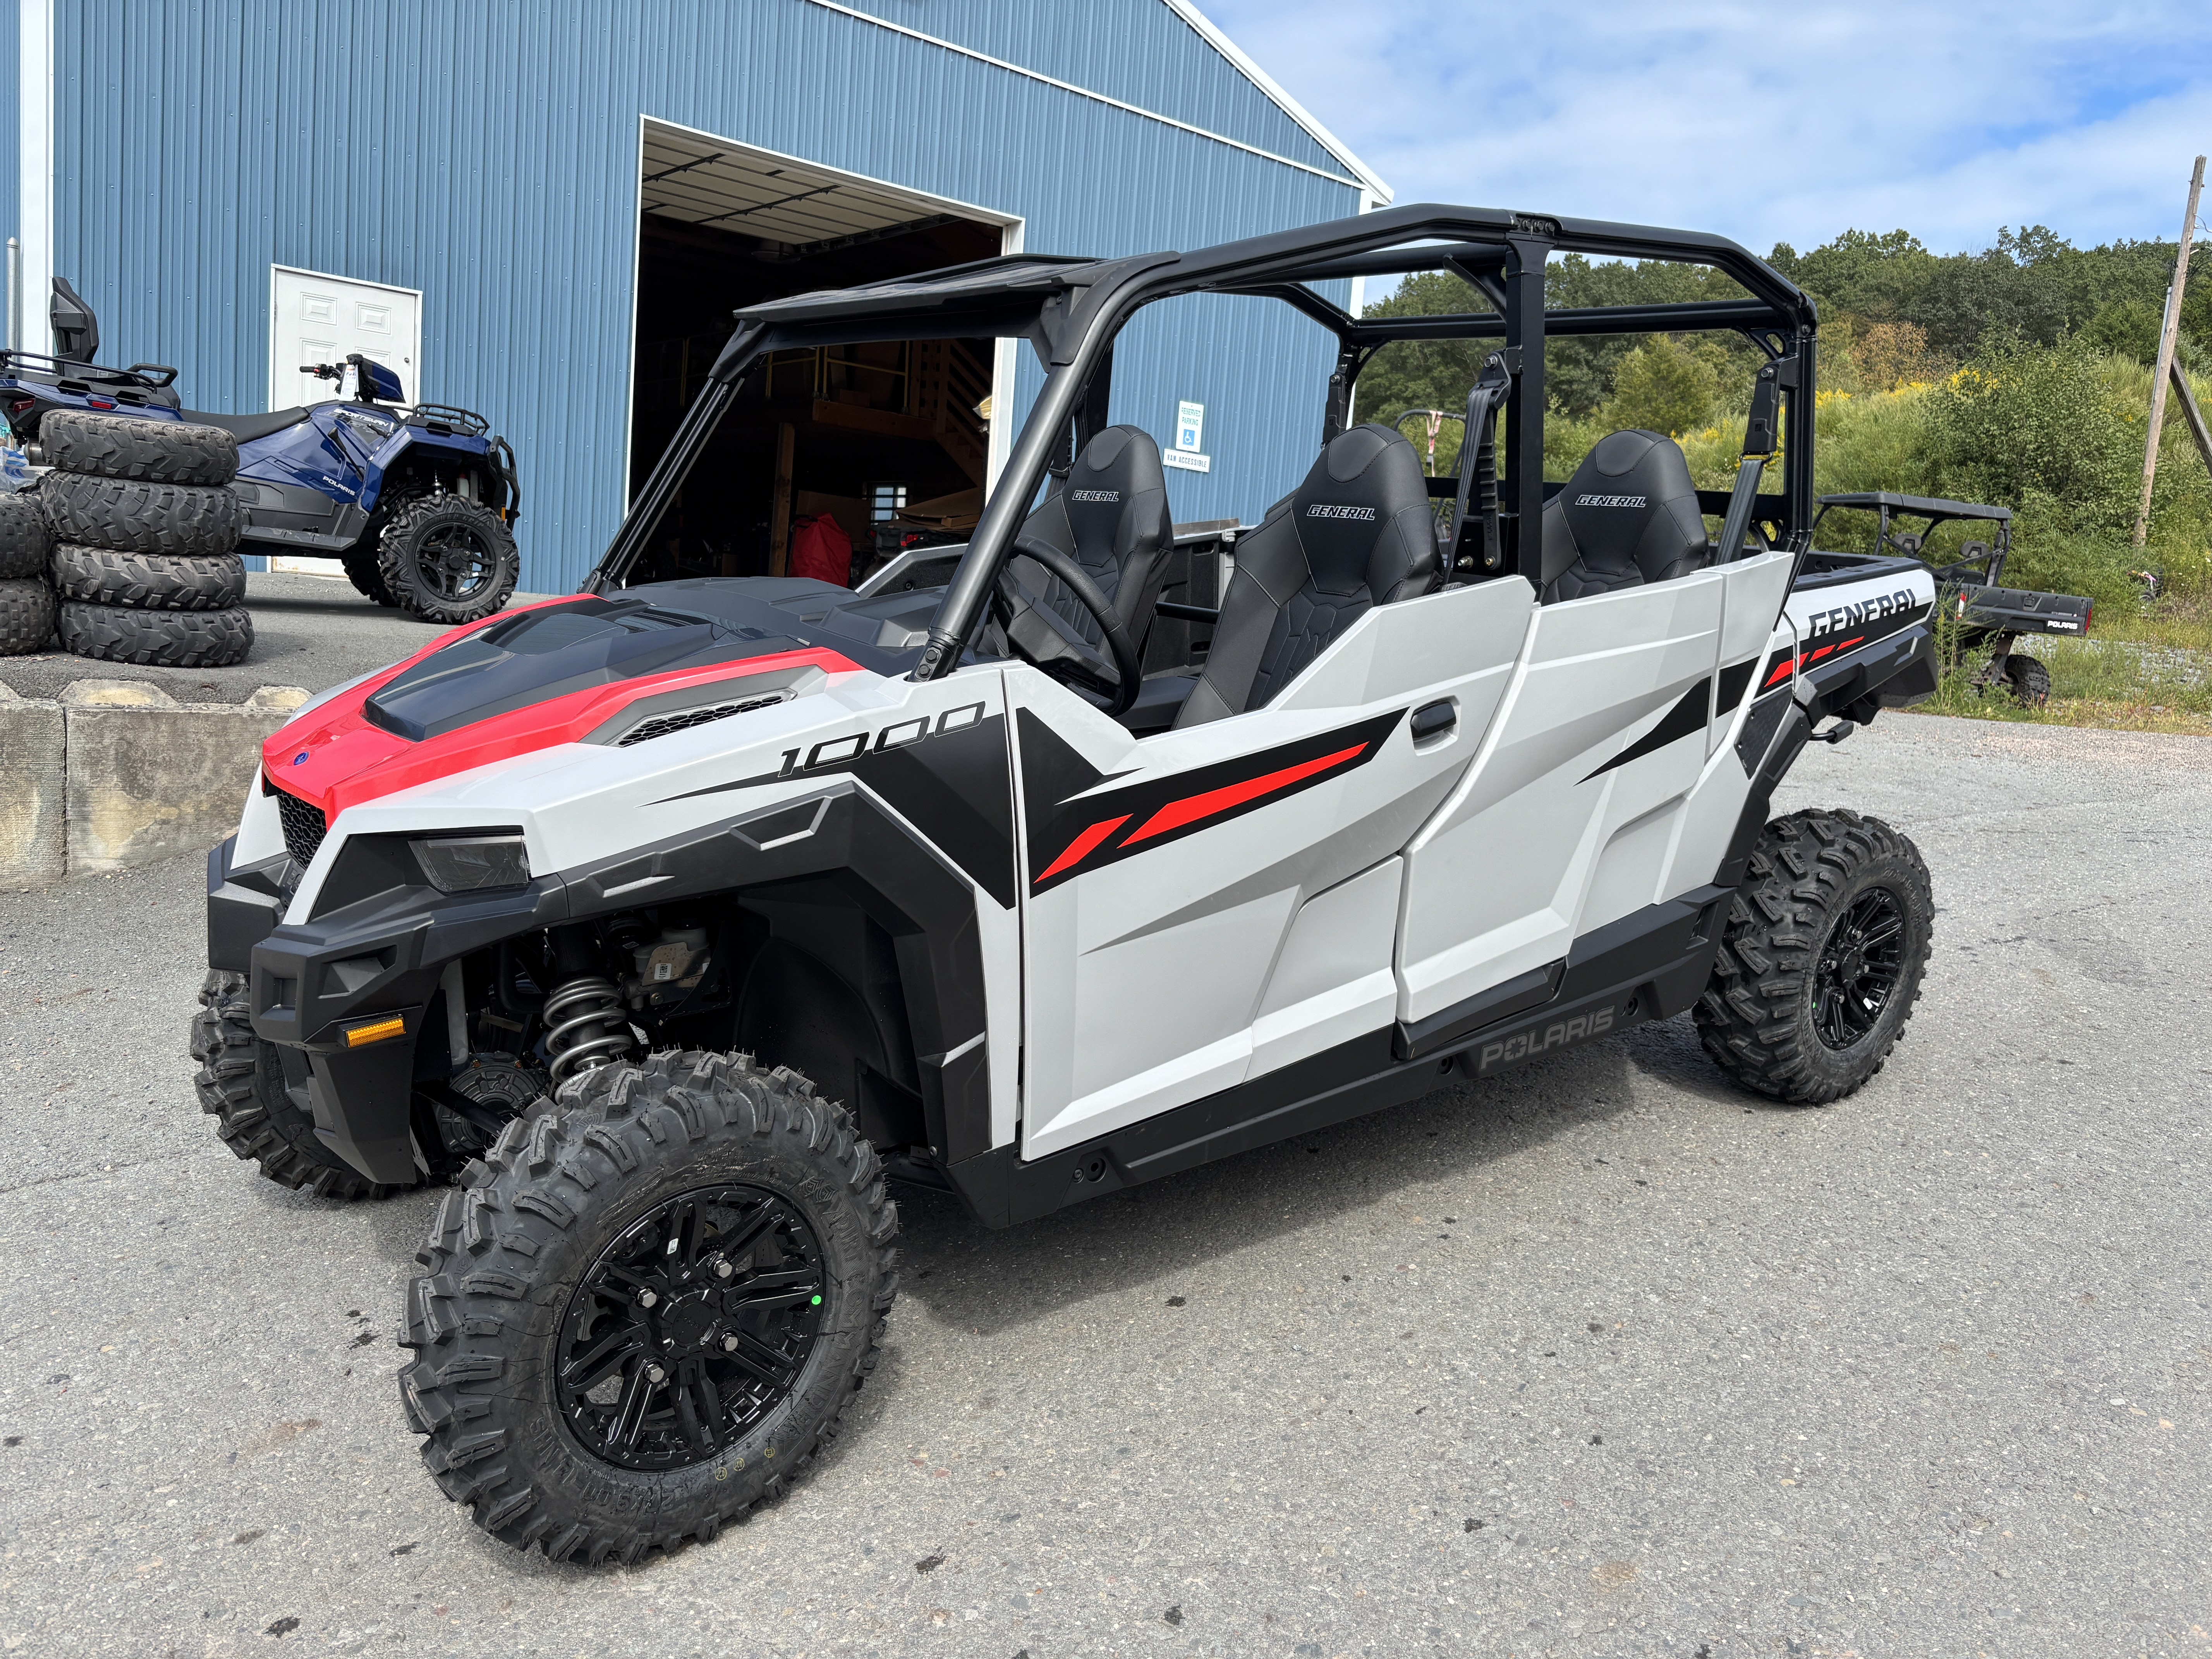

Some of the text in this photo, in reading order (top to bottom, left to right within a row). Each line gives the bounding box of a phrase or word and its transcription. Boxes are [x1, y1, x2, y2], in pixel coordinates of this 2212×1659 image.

[333, 409, 388, 426] SPORTSMAN
[1181, 407, 1200, 417] RESERVED
[1182, 417, 1198, 426] PARKING
[1178, 457, 1207, 468] ACCESSIBLE
[323, 476, 355, 496] POLARIS
[1072, 490, 1119, 501] GENERAL
[1575, 495, 1646, 508] GENERAL
[1307, 505, 1375, 520] GENERAL
[1808, 588, 1918, 639] GENERAL
[2047, 620, 2078, 629] POLARIS
[778, 701, 986, 777] 1000
[1479, 1005, 1615, 1071] POLARIS
